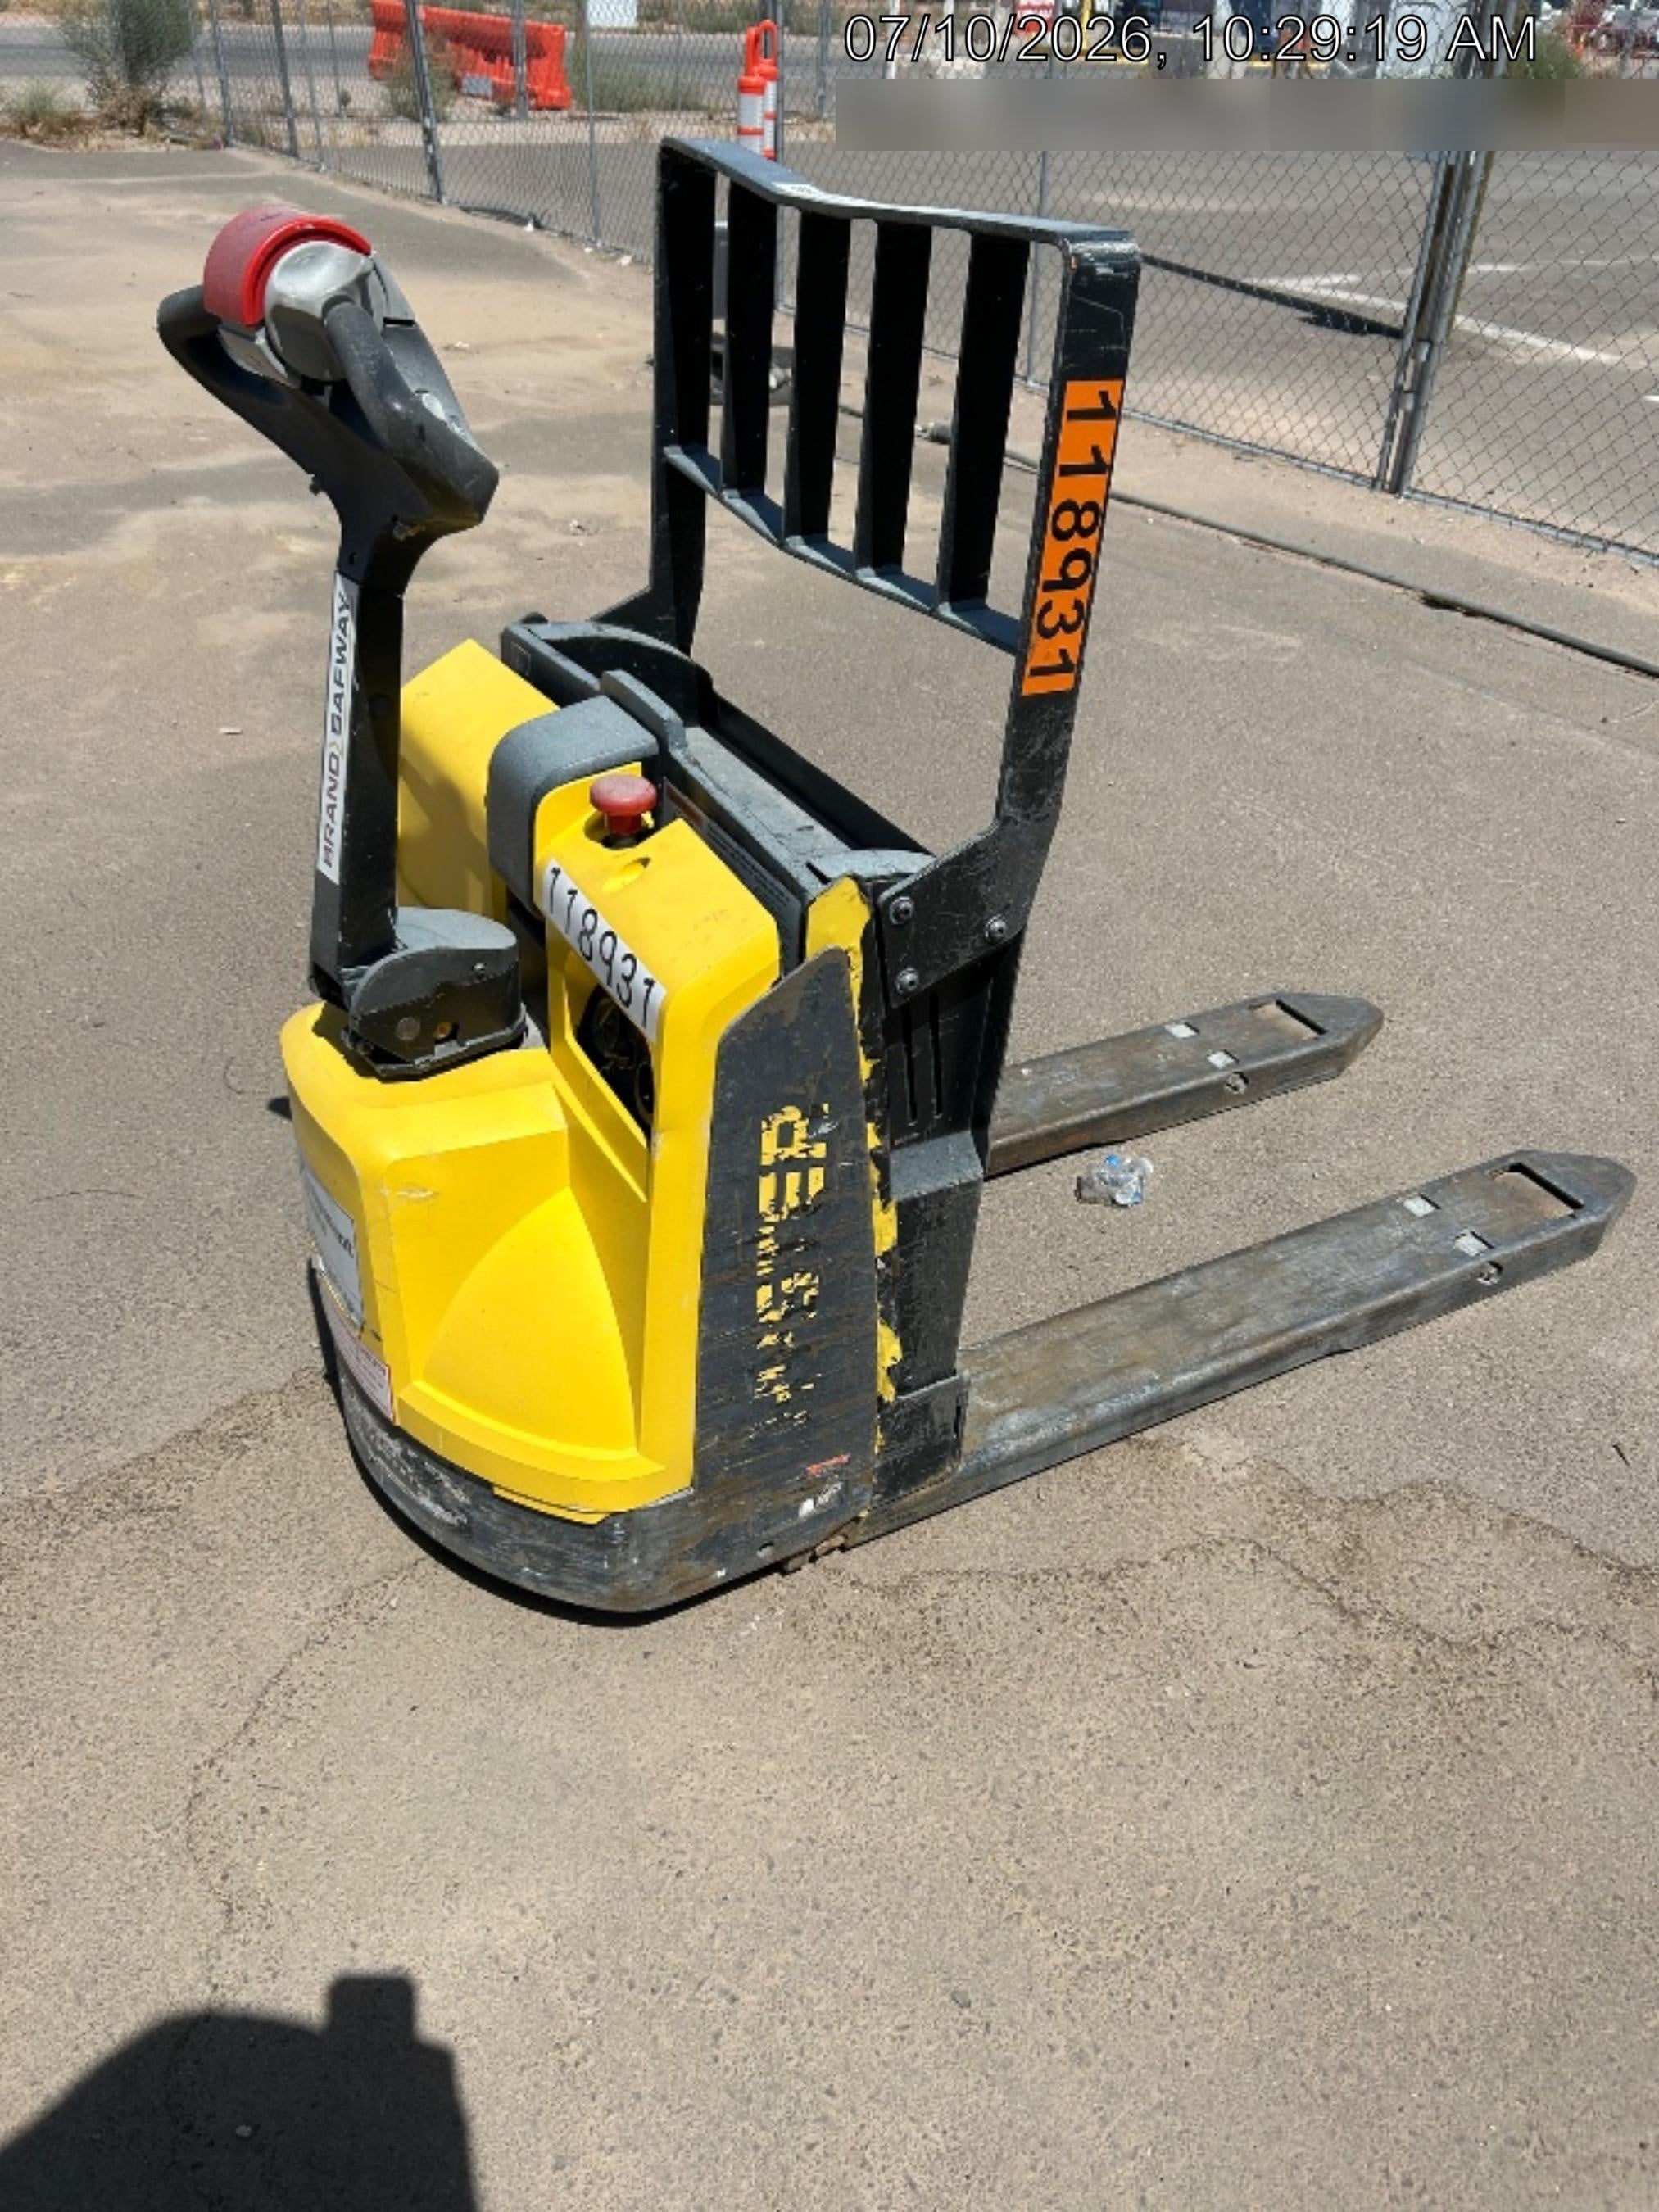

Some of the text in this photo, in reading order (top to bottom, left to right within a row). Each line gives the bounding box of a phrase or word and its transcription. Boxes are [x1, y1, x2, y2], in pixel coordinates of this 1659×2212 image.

[1029, 389, 1117, 678] 118931
[323, 591, 351, 868] BRAND SAFWAY
[549, 867, 656, 1027] 118931
